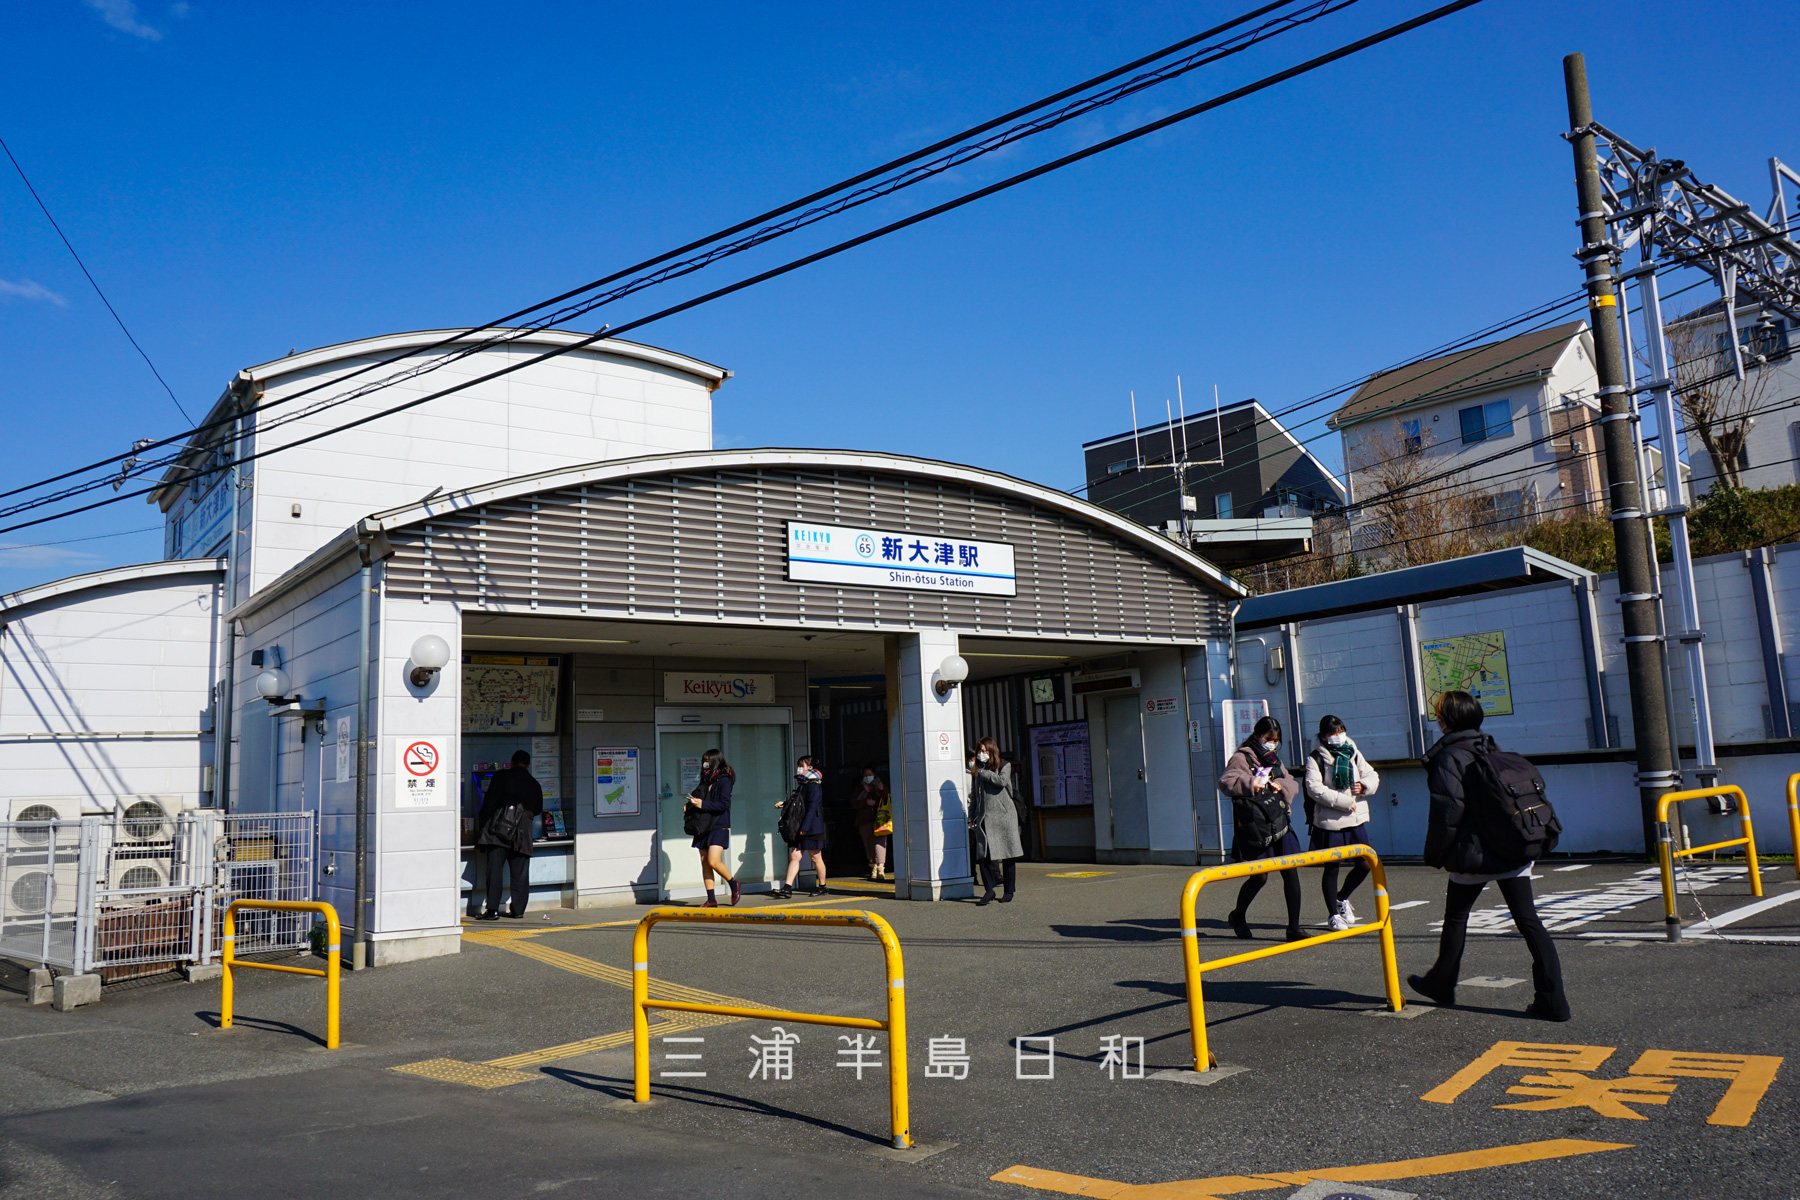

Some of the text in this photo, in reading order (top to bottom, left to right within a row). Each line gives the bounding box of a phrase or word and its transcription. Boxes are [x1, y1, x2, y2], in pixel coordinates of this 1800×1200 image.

[200, 483, 227, 531] 新大津駅
[794, 529, 831, 543] KEIKYU
[859, 543, 872, 553] 65
[881, 536, 979, 568] 新大津駅
[939, 575, 974, 588] Station
[683, 679, 732, 698] Keikyu
[407, 778, 436, 788] 禁煙
